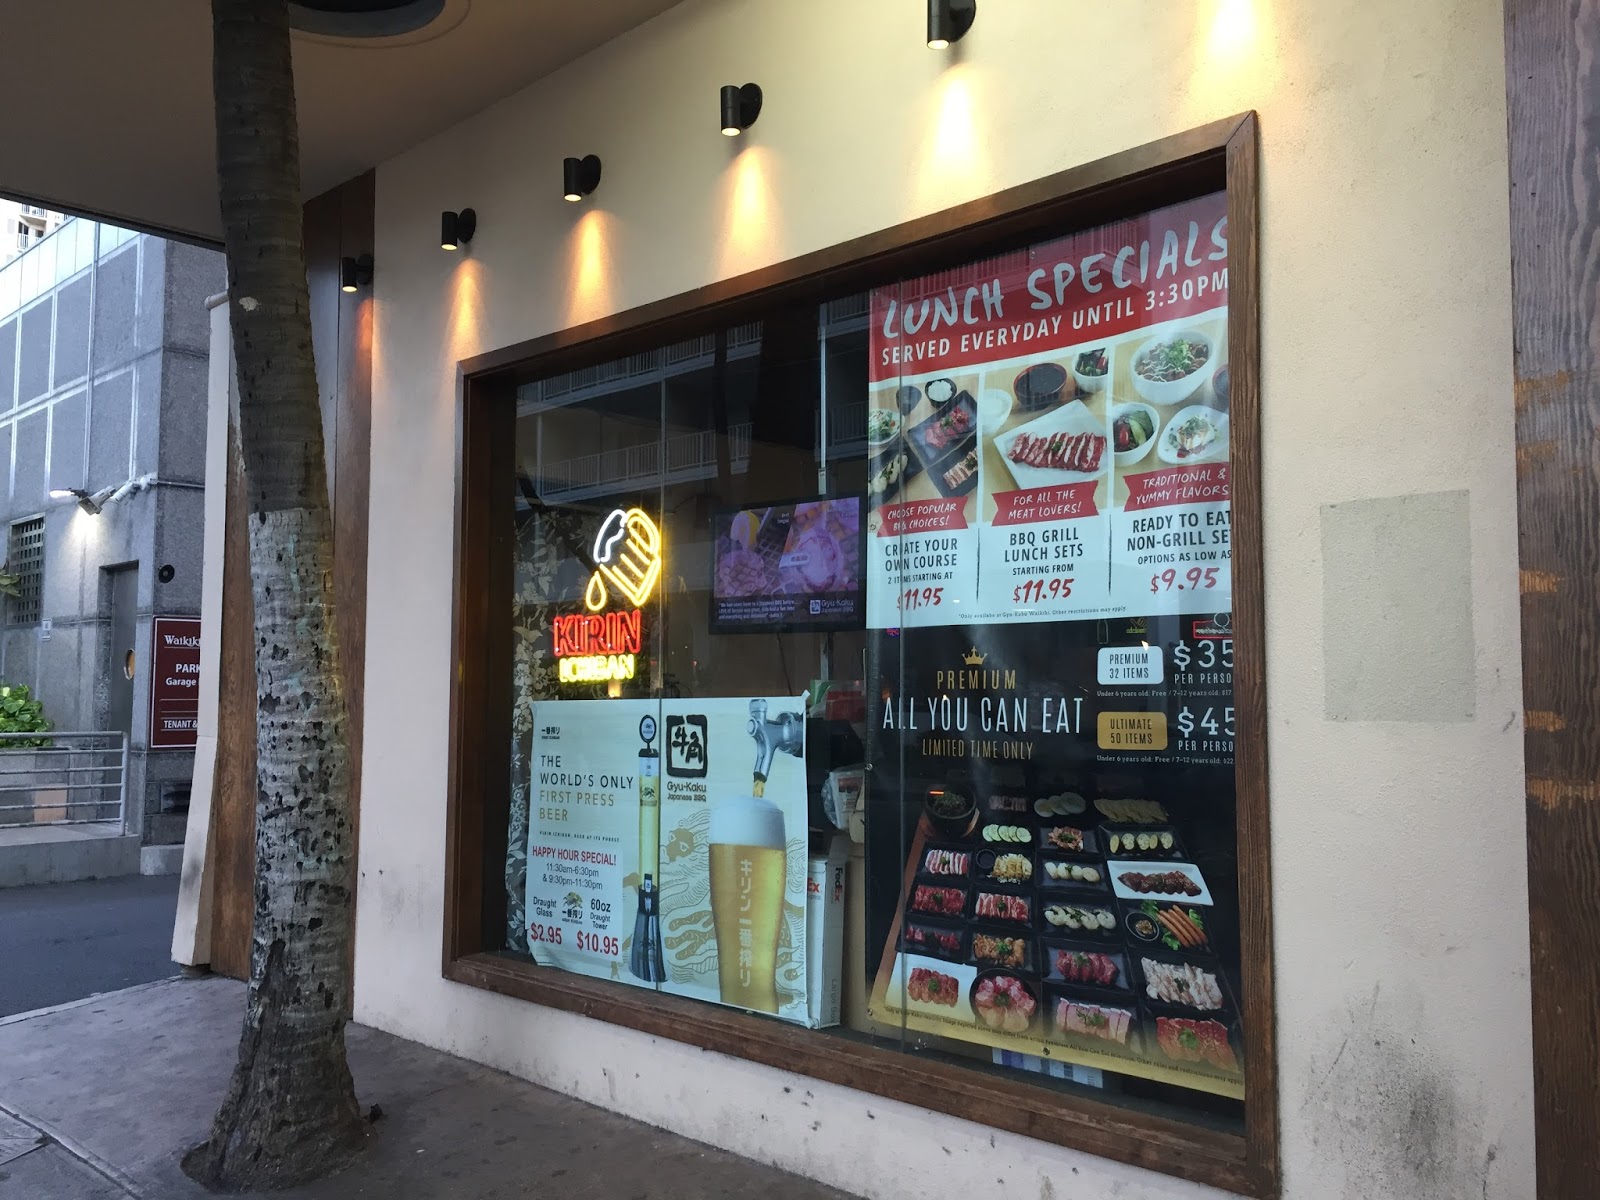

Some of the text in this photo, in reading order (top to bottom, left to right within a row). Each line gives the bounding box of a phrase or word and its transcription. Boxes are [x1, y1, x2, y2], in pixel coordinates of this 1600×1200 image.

[883, 215, 1228, 338] LUNCH SPECIALS
[882, 267, 1228, 366] SERVED EVERYDAY UNTIL 3:30PM
[1143, 468, 1226, 489] TRADITIONAL &
[1013, 490, 1076, 506] FOR ALL THE
[1136, 484, 1229, 505] YUMMY FLAVORS
[888, 503, 956, 520] CHOOSE POPULAR
[1008, 502, 1082, 520] MEAT LOVERS!
[909, 516, 950, 529] CHOICES!
[1132, 510, 1231, 534] READY TO EAT
[1010, 527, 1079, 546] BBQ GRILL
[1127, 529, 1231, 551] NON-GRILL SE
[885, 538, 958, 556] CRATE YOUR
[1004, 544, 1083, 562] LUNCH SETS
[885, 554, 958, 571] OWN COURSE
[1138, 550, 1231, 565] OPTIONS AS LOW AS
[894, 574, 911, 584] ITMS
[912, 573, 942, 582] STARTING
[944, 572, 953, 580] AT
[1012, 564, 1074, 576] STARTING FROM
[1150, 567, 1220, 594] $9.95
[1012, 578, 1074, 604] $11.95
[554, 609, 641, 656] KIRIN
[1109, 653, 1149, 665] PREMIUM
[1173, 640, 1233, 671] $35
[176, 664, 200, 673] PARK
[1109, 668, 1149, 679] 32 ITEMS
[166, 678, 196, 687] Garage
[936, 670, 1016, 690] PREMIUM
[1174, 673, 1194, 685] PER
[883, 697, 1083, 734] ALL YOU CAN EAT
[1178, 706, 1235, 738] $45
[164, 720, 198, 729] TENANT &
[1110, 719, 1152, 730] ULTIMATE
[1110, 732, 1152, 744] 50 ITEMS
[1178, 740, 1197, 751] PER
[922, 738, 1033, 760] LIMITED TIME ONLY
[541, 755, 561, 768] THE
[540, 773, 634, 789] WORLD'S ONLY
[667, 780, 706, 792] Gyu-Kaku
[540, 790, 614, 807] FIRST PRESS
[667, 792, 707, 802] Japanese BBQ
[540, 808, 568, 821] BEER
[532, 846, 617, 866] HAPPY HOUR SPECIAL!
[546, 863, 599, 877] 11:30am-6:30pm
[542, 874, 603, 890] & 9:30pm-11:30pm
[834, 867, 843, 902] FedEx
[533, 896, 557, 909] Draught
[590, 898, 611, 913] 60oz
[536, 907, 553, 918] Glass
[590, 912, 611, 923] Draught
[531, 922, 562, 945] $2.95
[592, 921, 608, 930] Tower
[577, 930, 619, 956] $10.95
